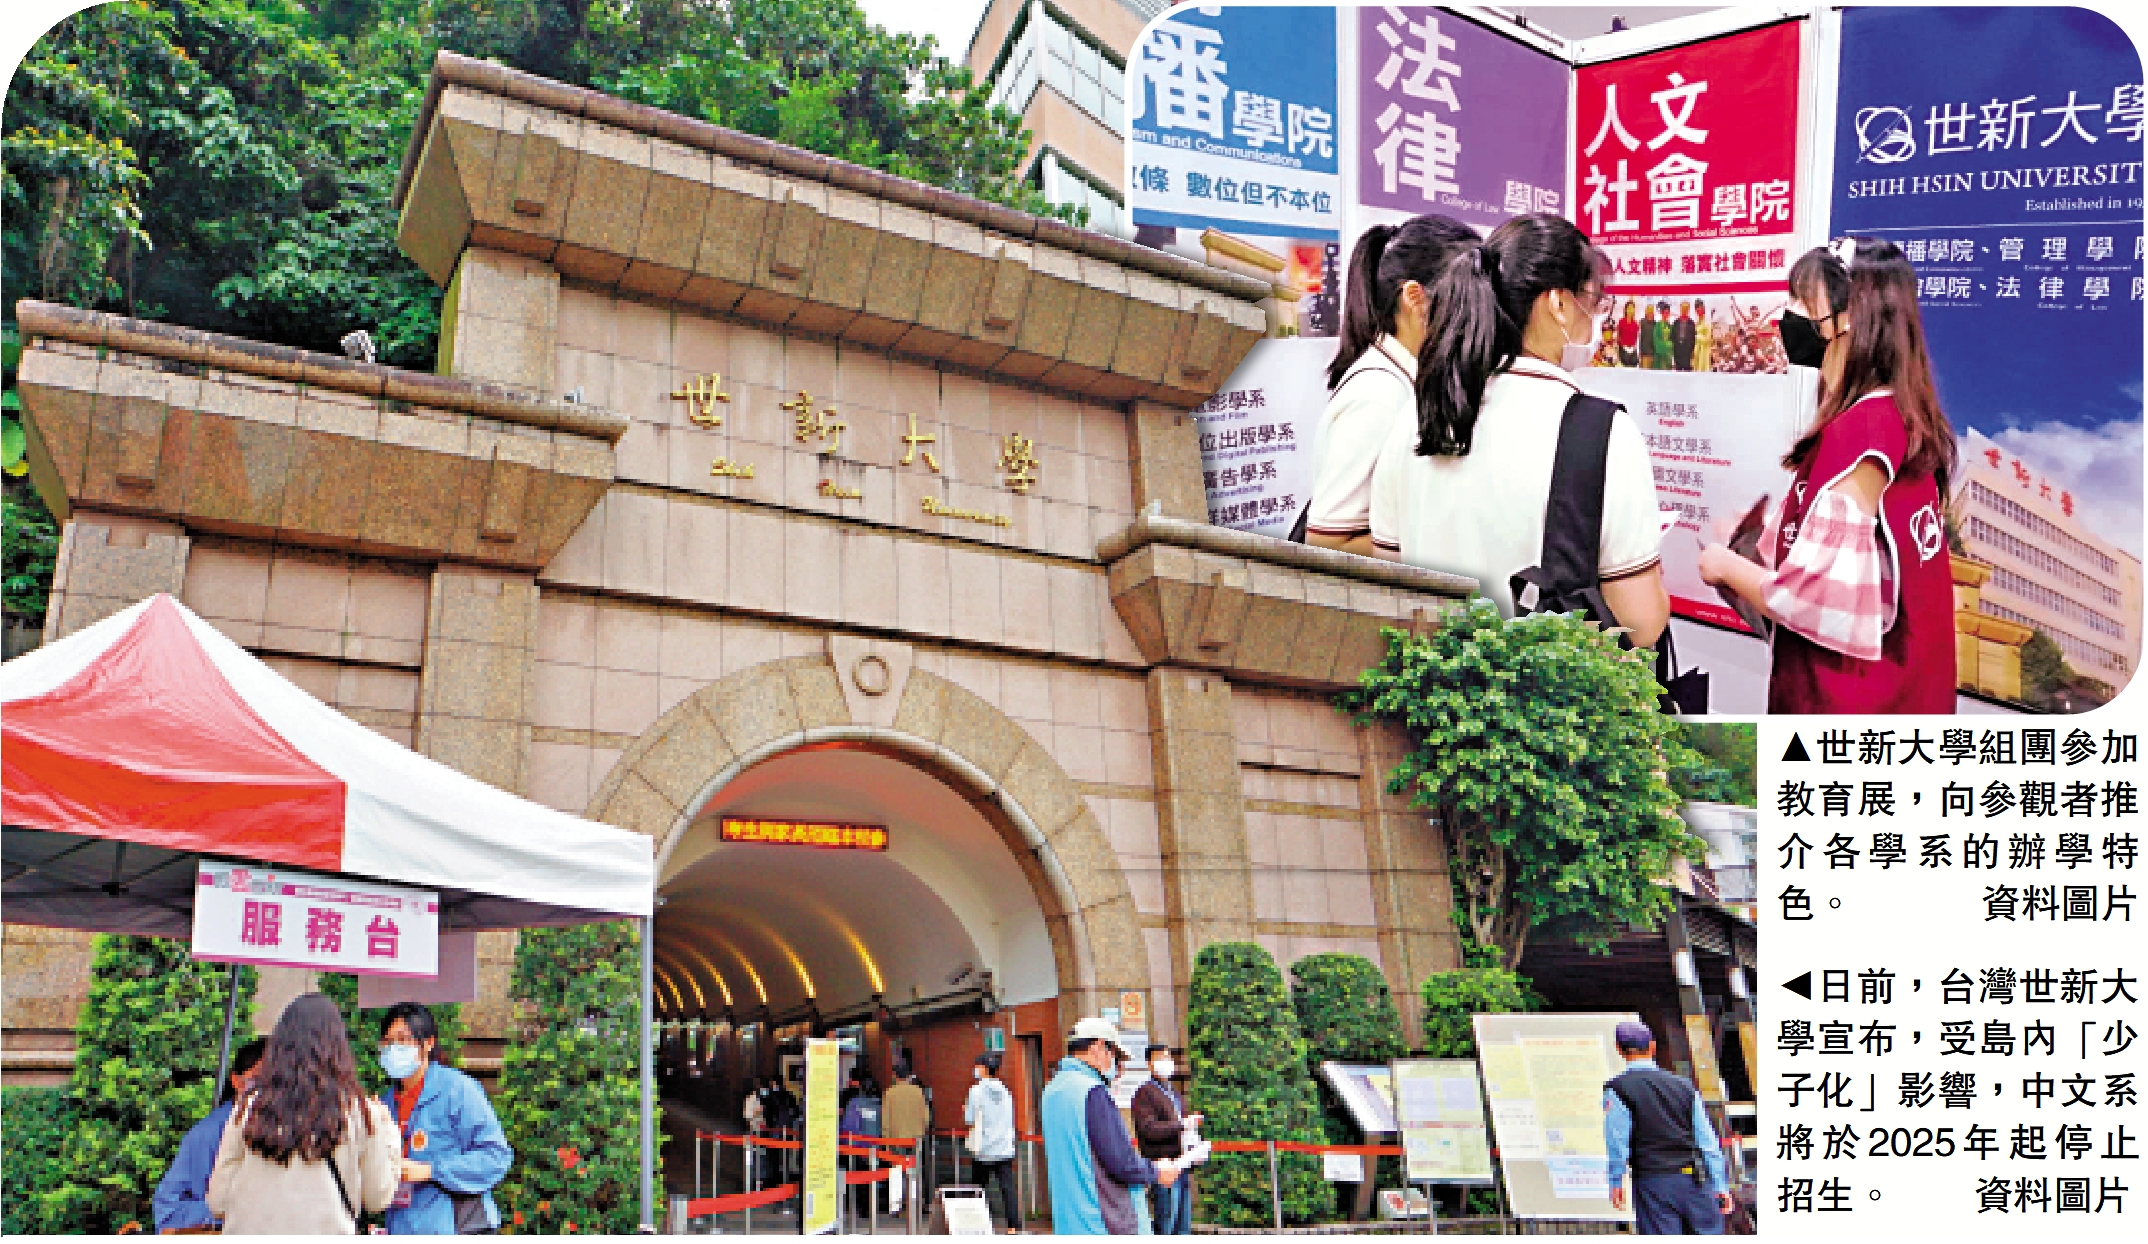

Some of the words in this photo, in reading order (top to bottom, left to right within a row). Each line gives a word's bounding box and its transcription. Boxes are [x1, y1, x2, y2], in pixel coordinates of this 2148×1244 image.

[1375, 6, 1462, 202] 法律
[1584, 72, 1709, 158] 人文
[1924, 83, 2144, 156] 世新大學
[1162, 133, 1191, 149] and
[1186, 171, 1333, 214] 數位但不本位
[1503, 180, 1560, 215] 學院
[1583, 153, 1791, 233] 社會學院
[1848, 178, 1905, 198] SHIH
[1912, 173, 1974, 195] HSIN
[1980, 162, 2143, 191] UNIVERSIT
[2025, 198, 2103, 211] Established
[2107, 196, 2121, 209] in
[2127, 196, 2144, 209] 19
[240, 900, 402, 959] 服務台
